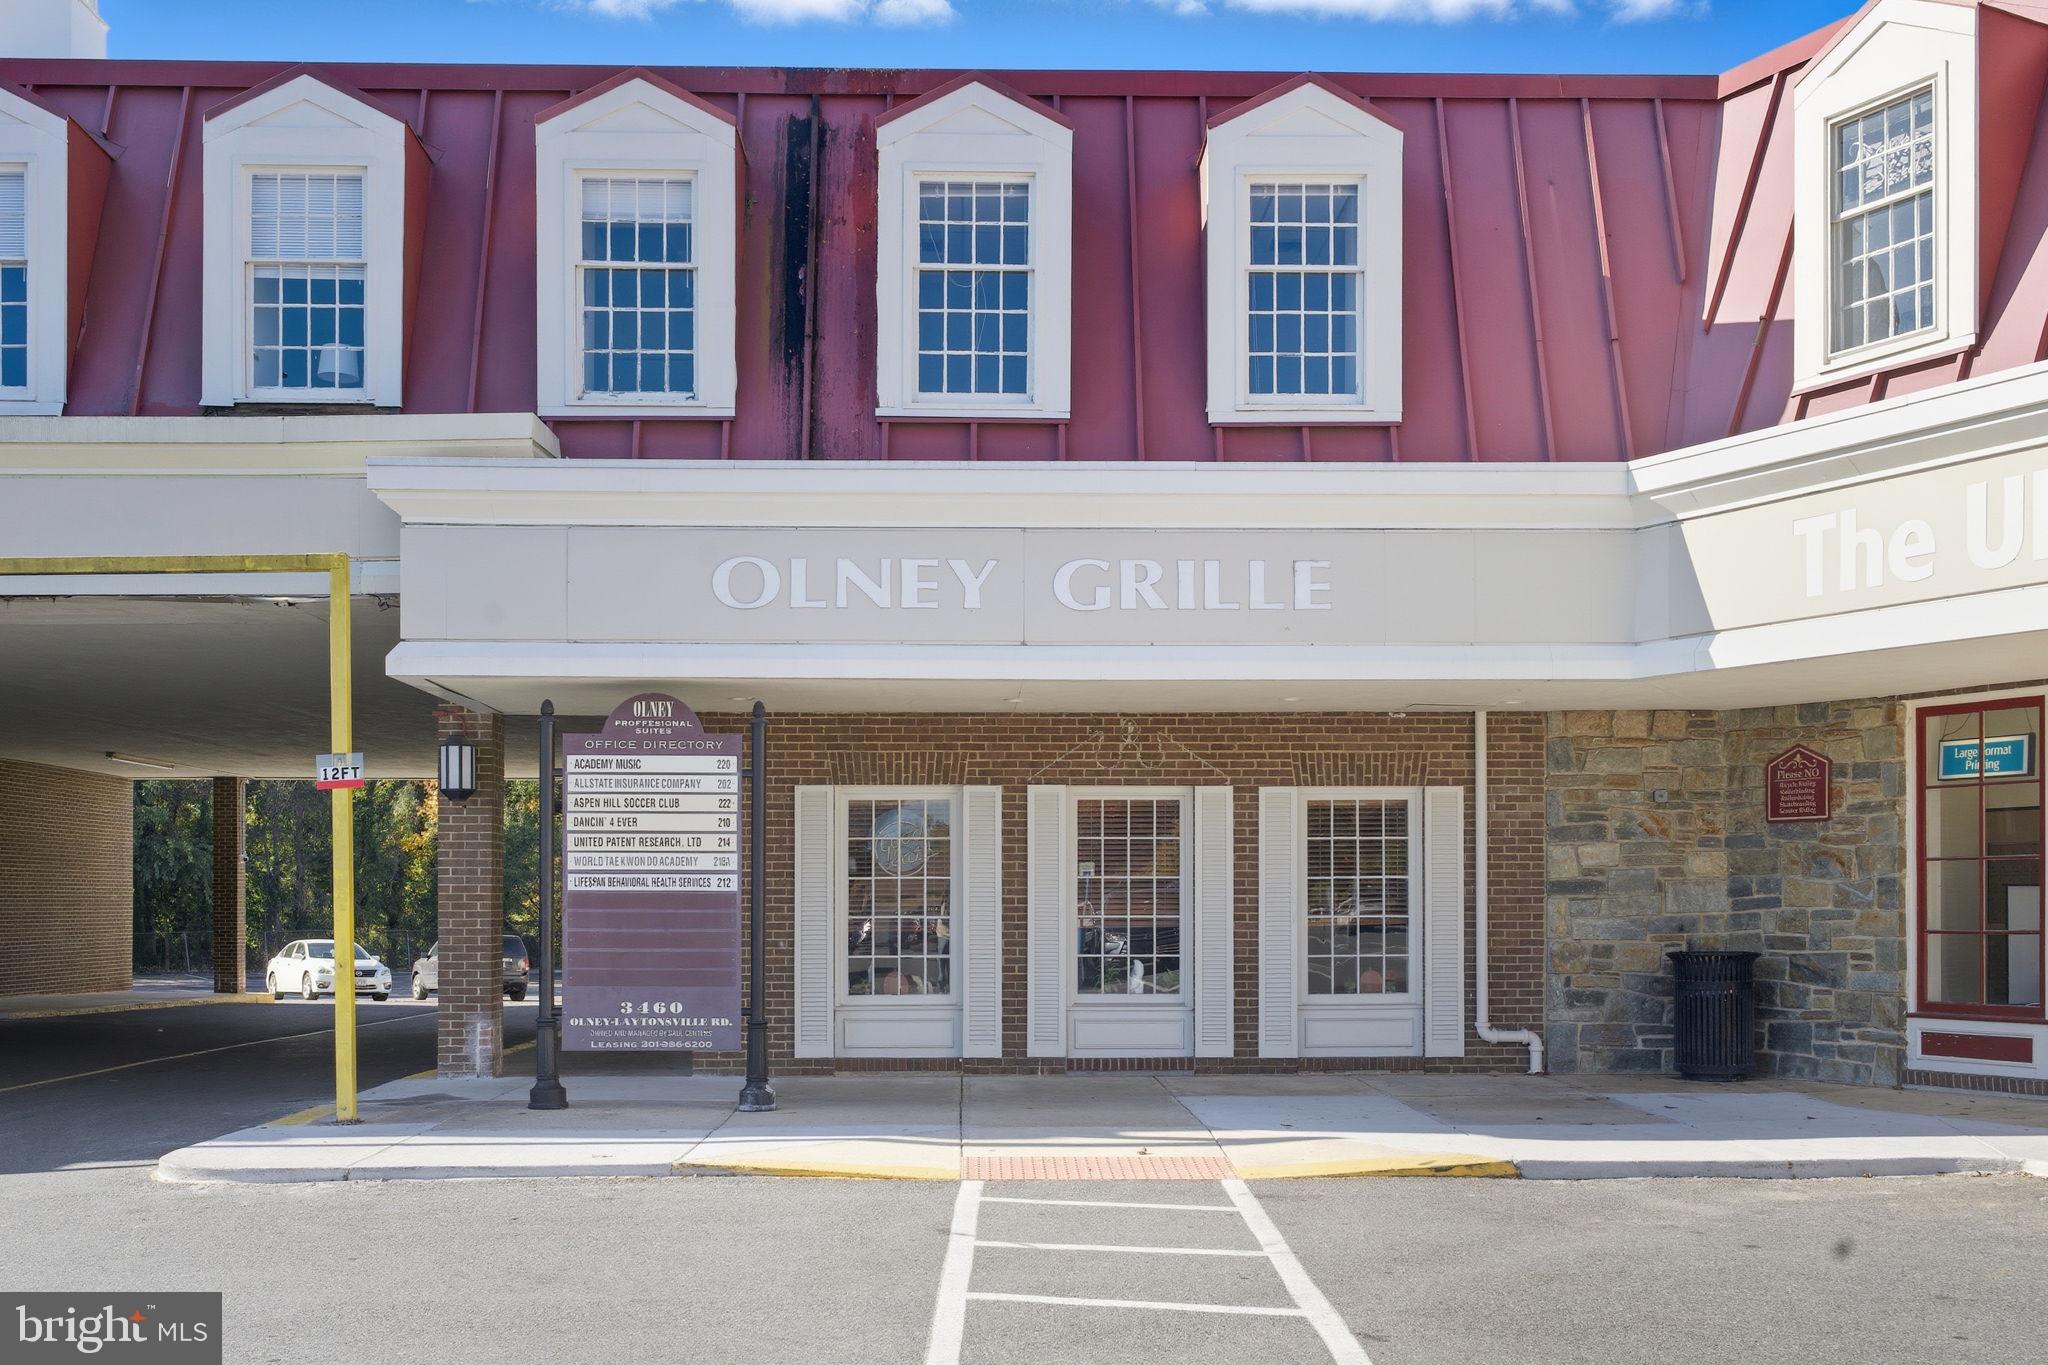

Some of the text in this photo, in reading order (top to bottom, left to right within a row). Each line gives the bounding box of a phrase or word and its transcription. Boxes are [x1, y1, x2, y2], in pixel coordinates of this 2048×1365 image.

[1793, 508, 1936, 598] The
[711, 555, 1333, 611] OLNEY GRILLE
[633, 700, 674, 718] OLNEY
[584, 740, 723, 750] OFFICE DIRECTORY
[1954, 745, 2012, 760] Large ormat
[574, 758, 731, 770] ACADEMY MUSIC 220
[1777, 767, 1820, 779] Please NO
[574, 778, 732, 789] ALLSTATE INSURANCE COMPANY 202
[573, 797, 732, 809] ASPEN HILL SOCCER CLUB 222
[609, 817, 615, 827] 4
[617, 817, 638, 827] EVER
[718, 817, 731, 828] 210
[573, 837, 604, 847] UNITED
[606, 836, 636, 847] PATENT
[687, 837, 702, 847] LTD
[717, 837, 731, 847] 214
[574, 856, 604, 867] WORLD
[659, 856, 698, 867] ACADEMY
[573, 877, 731, 888] LIFESPAN BEHAVIORAL HEALTH SERVICES 212
[620, 1001, 683, 1014] 3460
[570, 1017, 733, 1027] OLNEY-LAYTONSVILLE RD.
